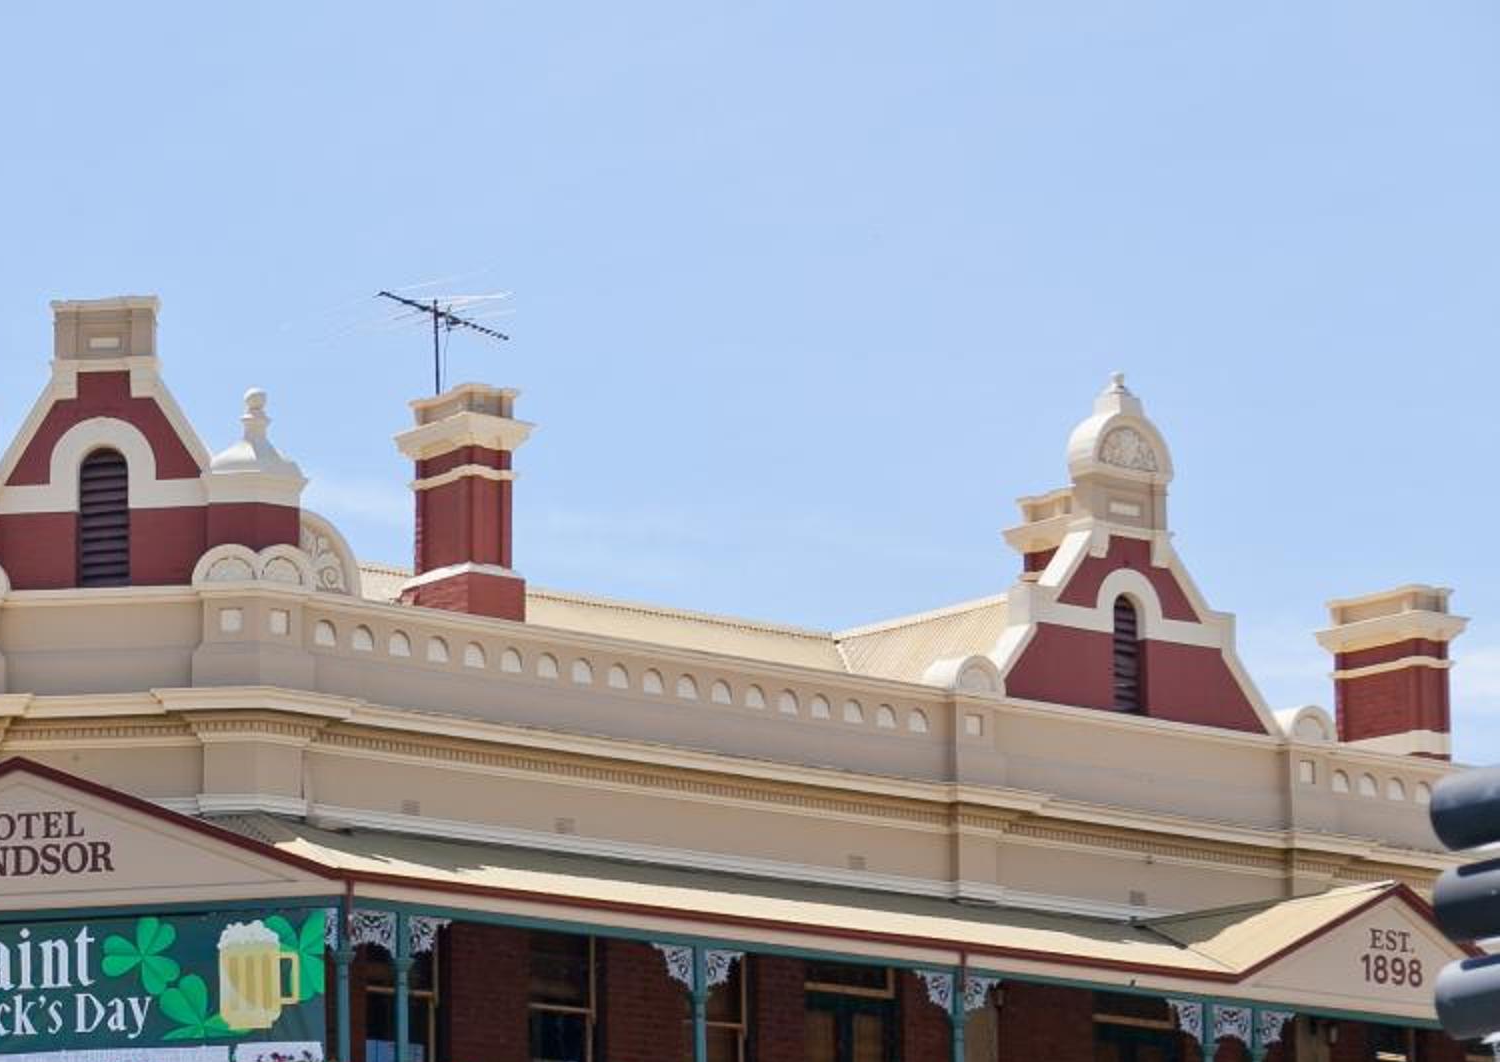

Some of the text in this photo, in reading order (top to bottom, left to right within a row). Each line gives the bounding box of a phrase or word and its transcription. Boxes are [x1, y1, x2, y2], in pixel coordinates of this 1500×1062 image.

[1369, 927, 1415, 954] EST.
[1361, 953, 1423, 988] 1898
[74, 992, 153, 1039] Day
